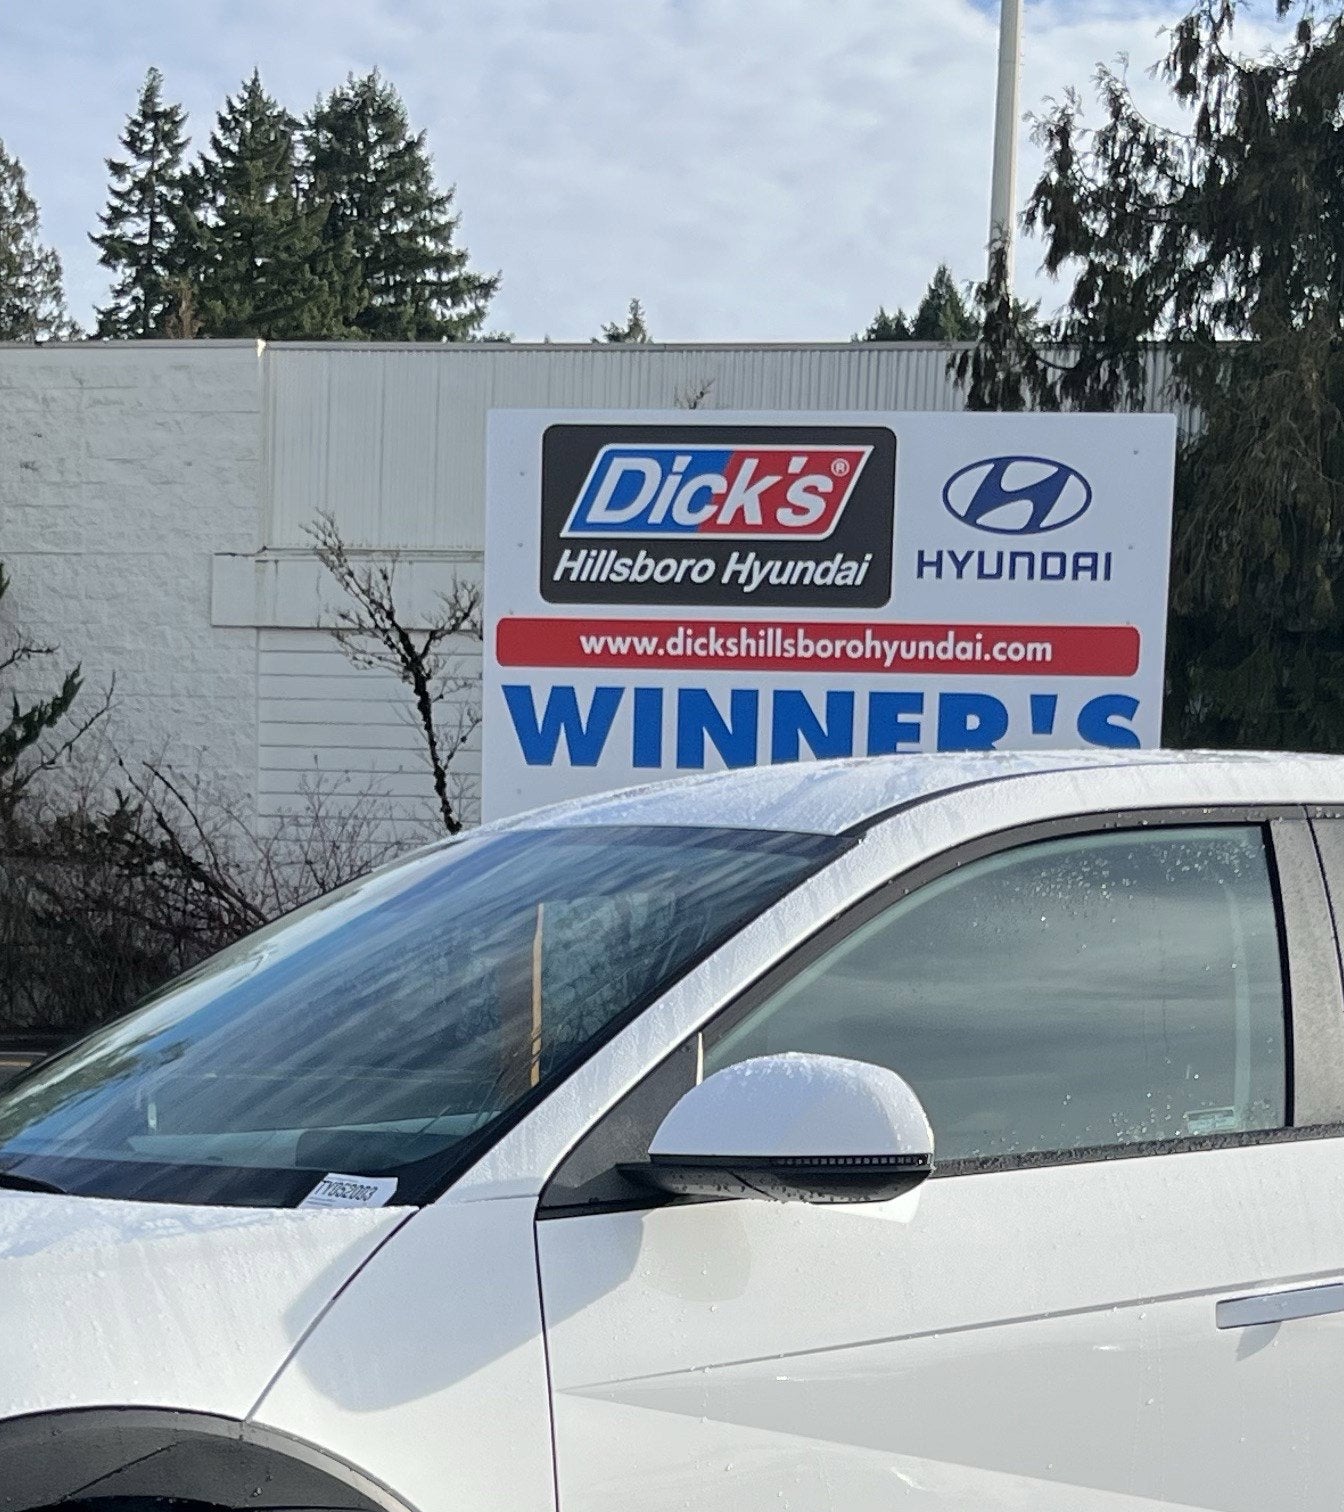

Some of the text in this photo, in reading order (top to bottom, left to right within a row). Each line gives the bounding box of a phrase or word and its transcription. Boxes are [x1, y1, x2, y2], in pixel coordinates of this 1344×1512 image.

[586, 456, 833, 527] Dick's
[553, 549, 873, 592] Hillsboro Hyundai
[916, 549, 1112, 581] HYUNDAI
[579, 626, 1053, 667] www.dickshillsborohyundai.com
[501, 684, 1141, 769] WINNER'S
